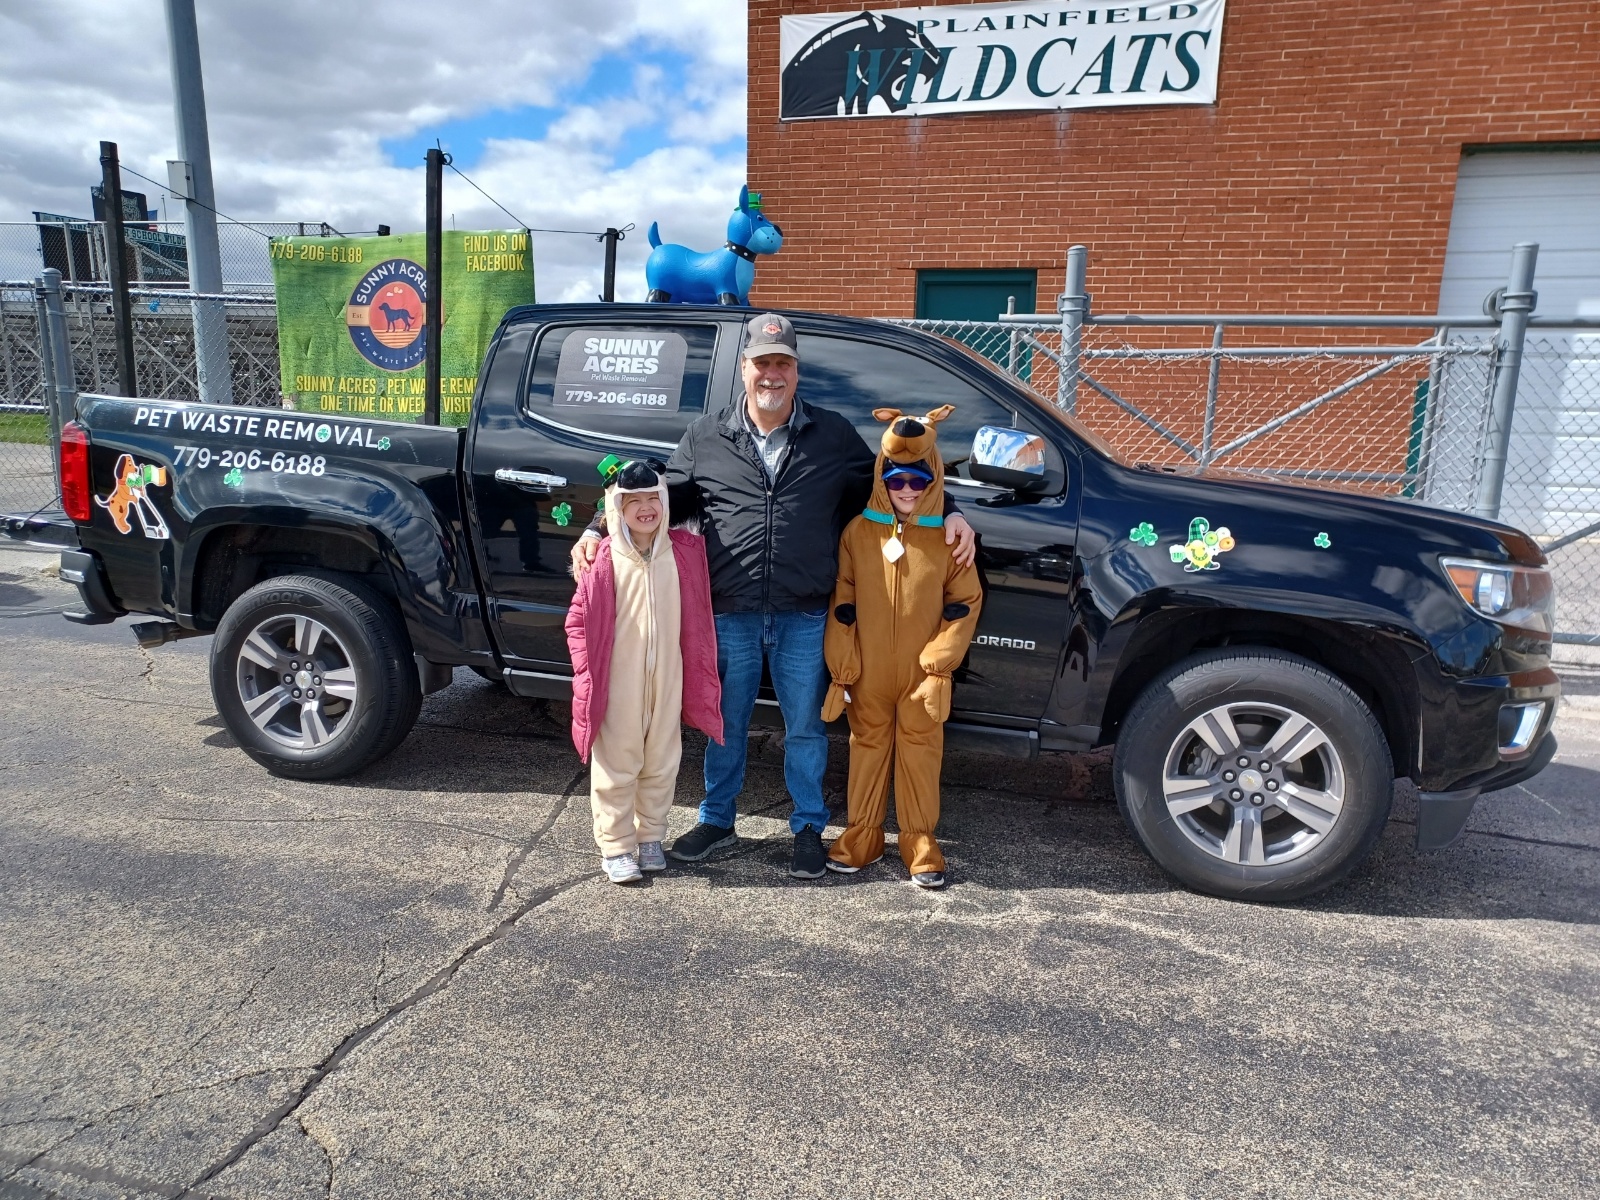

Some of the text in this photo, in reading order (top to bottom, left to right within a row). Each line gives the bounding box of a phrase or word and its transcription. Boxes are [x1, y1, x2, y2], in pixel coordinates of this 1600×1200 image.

[916, 3, 1199, 34] PLAINFIELD
[845, 29, 1212, 105] WILDCATS
[132, 230, 161, 241] SCHOOL
[464, 233, 526, 253] FIND US ON
[270, 242, 362, 263] 779-206-6188
[467, 254, 525, 272] FACEBOOK
[356, 262, 427, 304] SUNNY ACRE
[360, 332, 370, 347] PET
[372, 351, 399, 365] WASTE
[583, 337, 665, 356] SUNNY
[582, 356, 659, 374] ACRES
[296, 375, 335, 392] SUNNY
[338, 377, 376, 394] ACRES
[387, 378, 406, 394] PET
[602, 374, 620, 382] Waste
[320, 395, 342, 411] ONE
[347, 395, 375, 412] TIME
[379, 396, 394, 412] OR
[565, 390, 667, 406] 779-206-6188
[134, 407, 378, 448] PET WASTE REMOVAL
[173, 445, 326, 477] 779-206-6188
